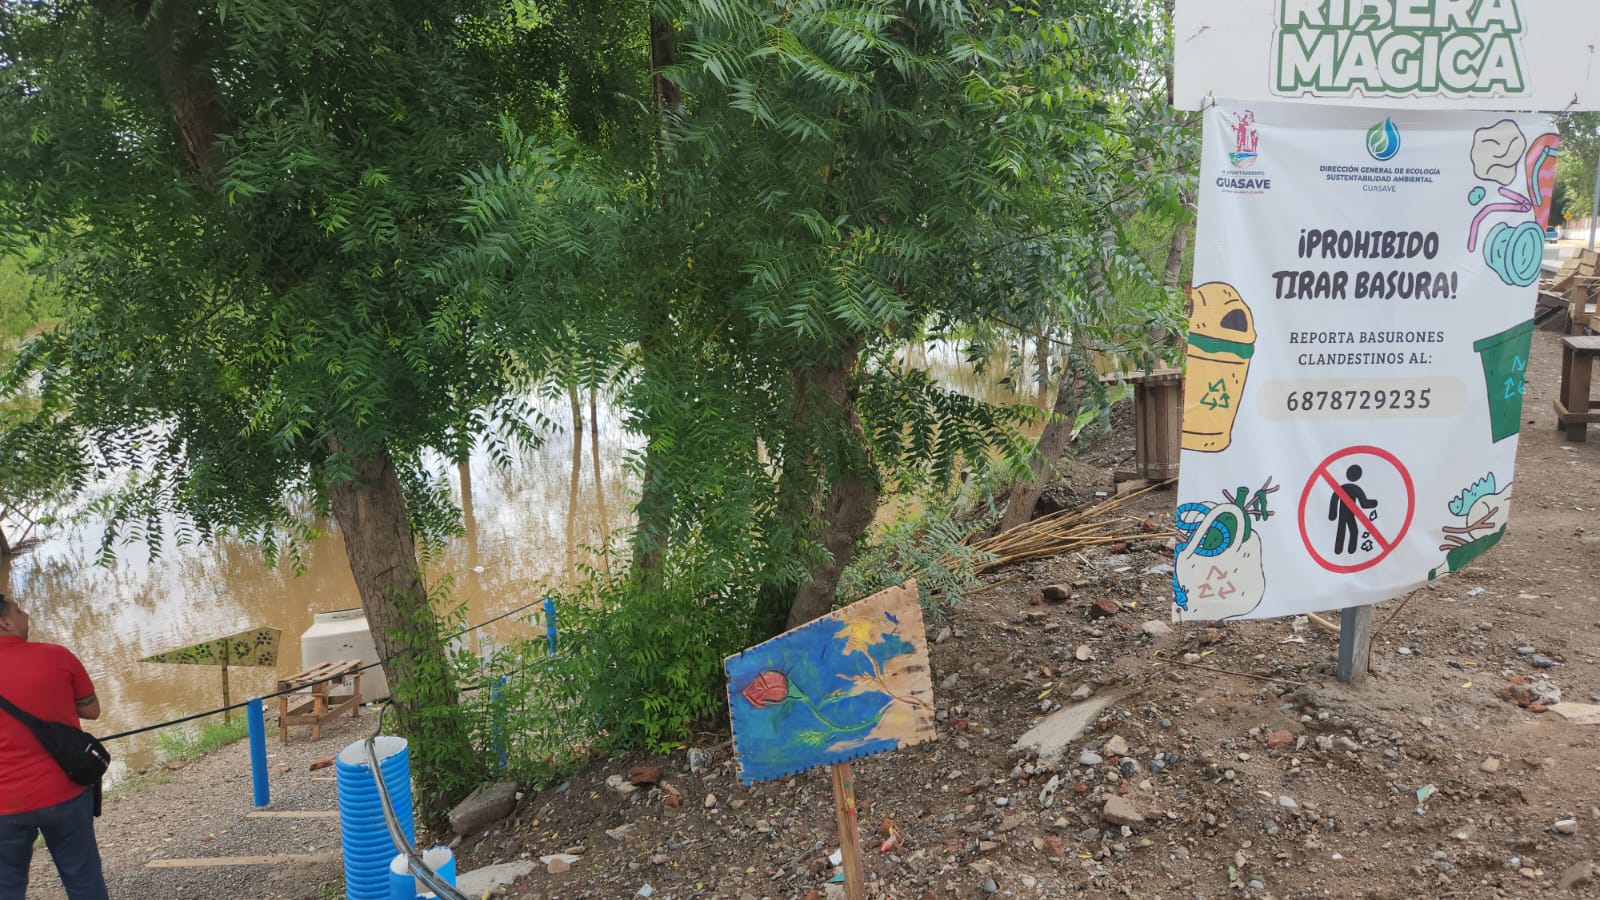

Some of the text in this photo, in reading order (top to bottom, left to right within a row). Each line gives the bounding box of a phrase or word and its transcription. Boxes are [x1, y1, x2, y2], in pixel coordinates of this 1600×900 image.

[1277, 17, 1525, 92] MÁGICA
[1320, 164, 1359, 173] DIRECCIÓN
[1360, 166, 1393, 174] GENERAL
[1405, 167, 1441, 175] ECOLOGÍA
[1216, 177, 1271, 189] GUASAVE
[1326, 174, 1433, 183] SUSTENTABILIDAD AMBIENTAL
[1362, 184, 1396, 192] GUASAVE
[1298, 229, 1440, 260] ¡PROHIBIDO
[1271, 270, 1458, 300] TIRAR BASURA!
[1289, 331, 1445, 344] REPORTA BASURONES
[1298, 352, 1433, 365] CLANDESTINOS AL:
[1287, 387, 1432, 412] 6878729235
